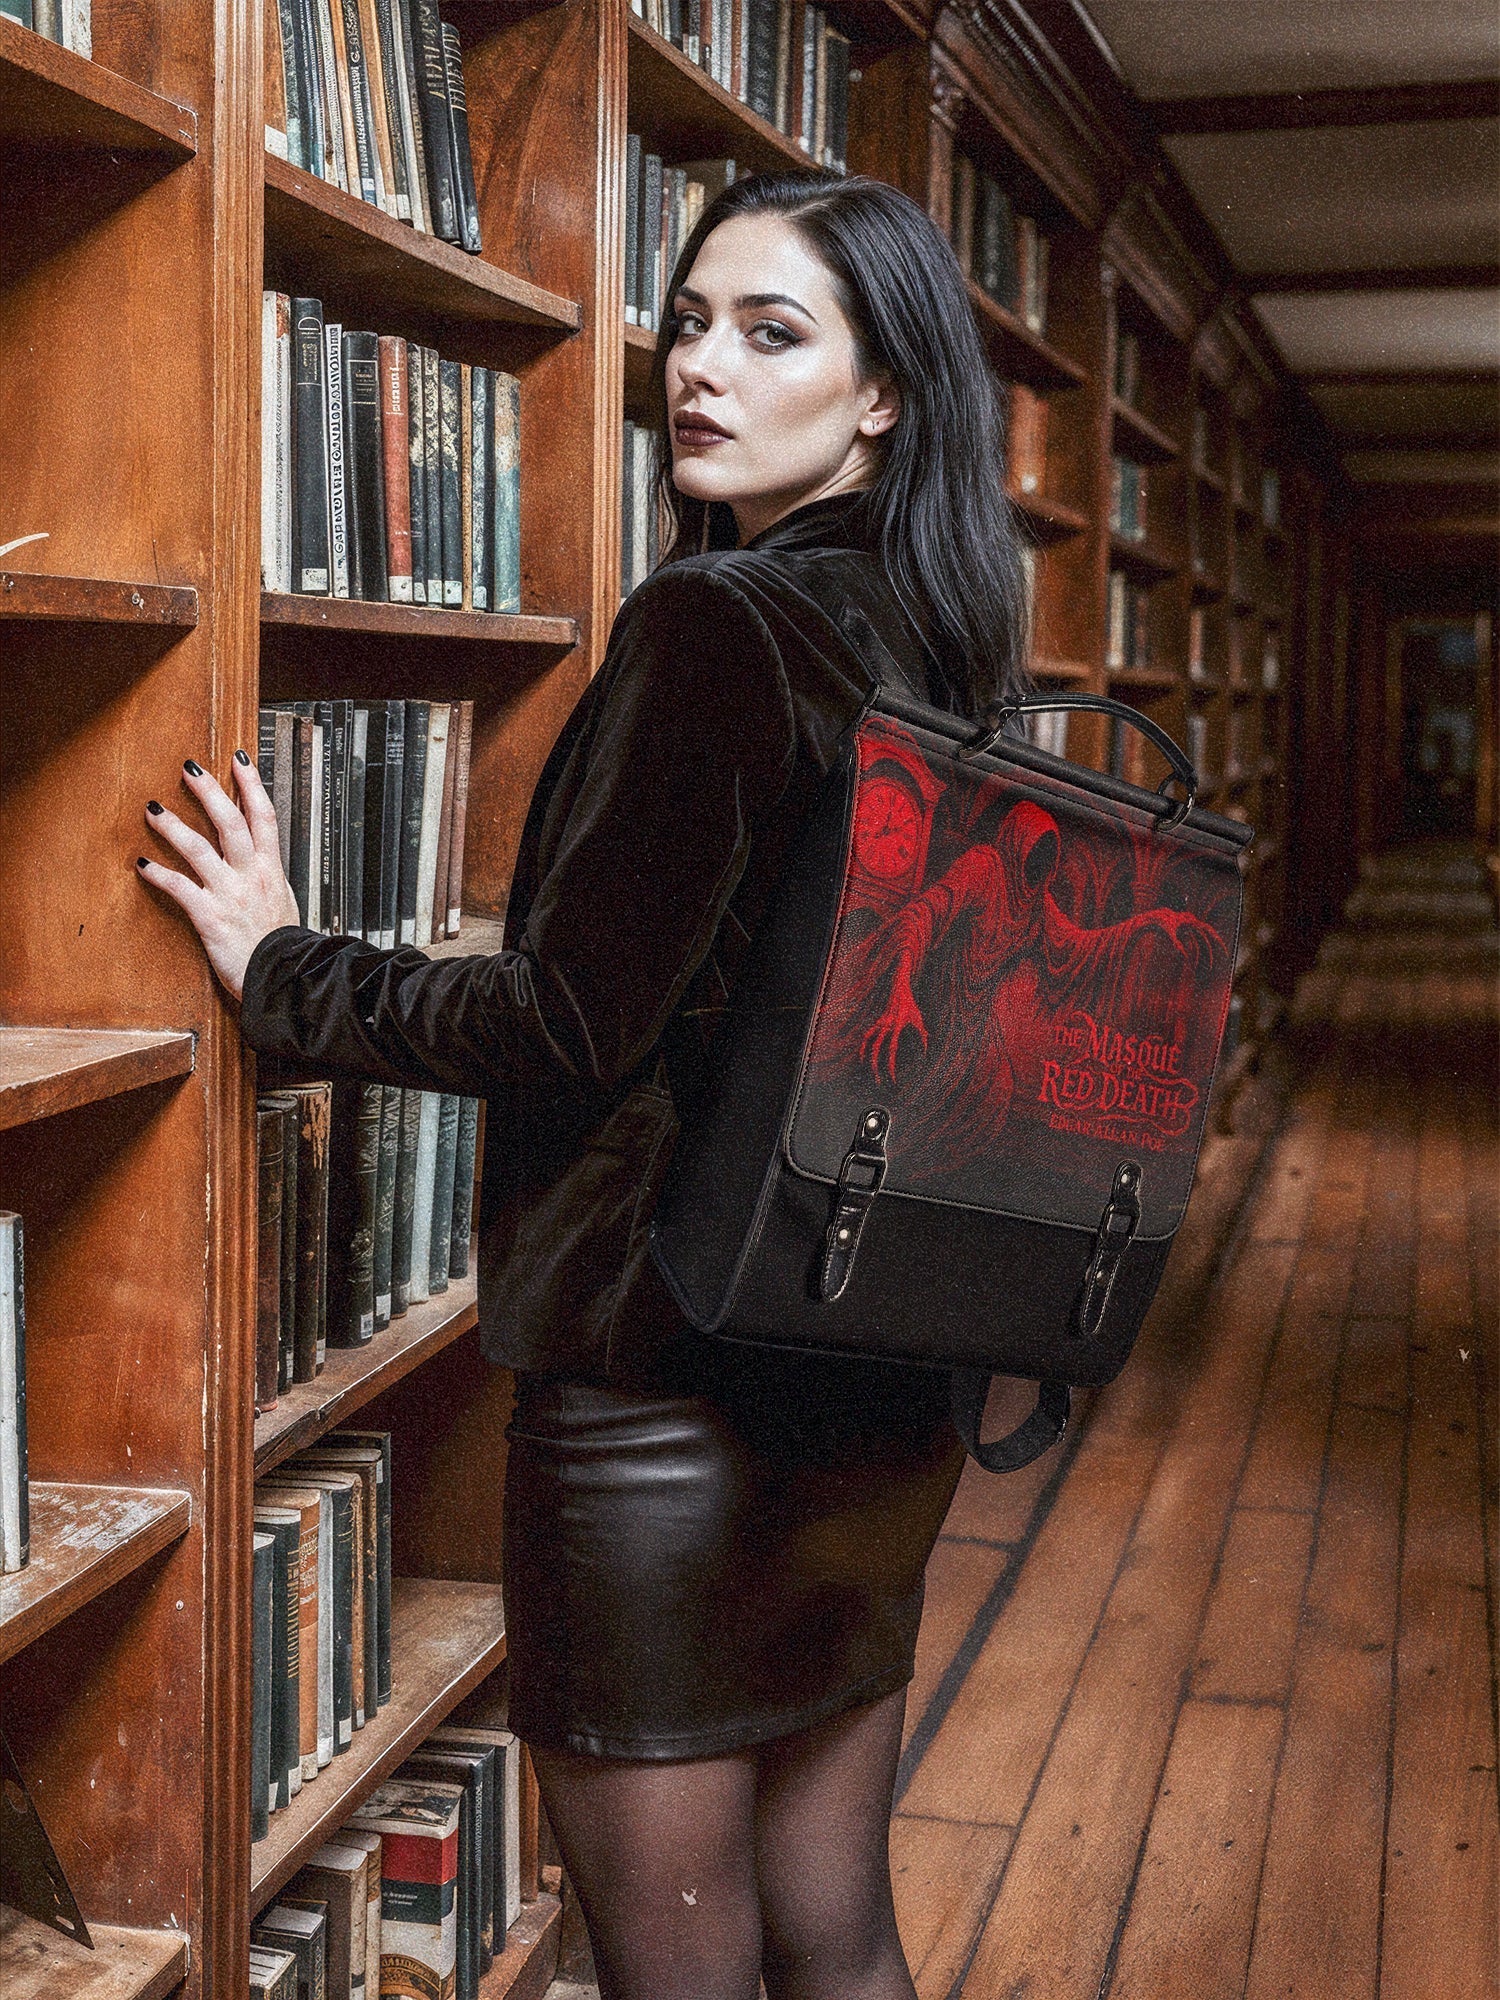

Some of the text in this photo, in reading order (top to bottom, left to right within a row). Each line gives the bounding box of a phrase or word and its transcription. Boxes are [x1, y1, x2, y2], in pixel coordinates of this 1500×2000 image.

[1053, 1011, 1182, 1075] THE MASQUE
[1037, 1060, 1194, 1122] RED DEATH
[1049, 1113, 1166, 1153] EDGAR ALLAN POE
